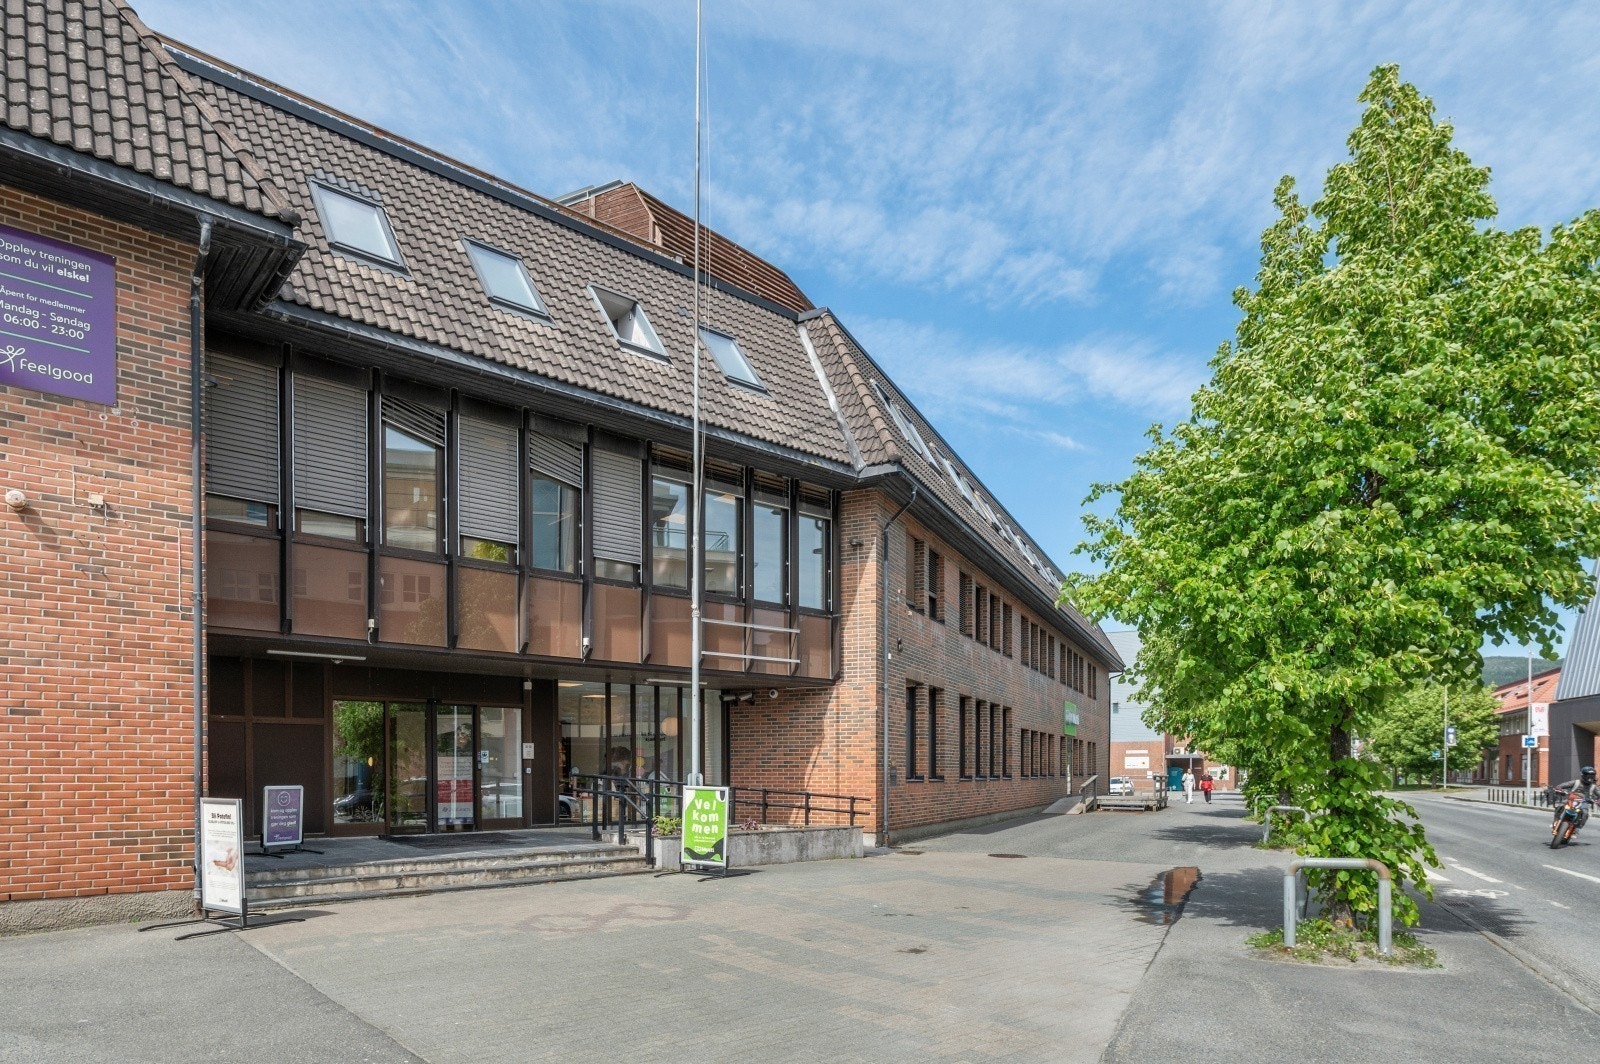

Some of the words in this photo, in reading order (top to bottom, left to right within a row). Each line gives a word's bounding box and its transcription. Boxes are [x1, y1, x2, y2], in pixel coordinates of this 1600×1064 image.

[24, 258, 39, 269] du
[41, 264, 54, 273] vil
[57, 268, 89, 283] elske!
[39, 251, 91, 271] treningen
[0, 284, 24, 298] Åpent
[26, 293, 38, 302] for
[39, 298, 86, 314] medlemmer
[3, 313, 39, 329] 06:00
[51, 324, 85, 340] 23:00
[50, 312, 91, 331] Søndag
[20, 358, 93, 384] feelgood
[692, 809, 719, 823] kom
[692, 823, 718, 834] men
